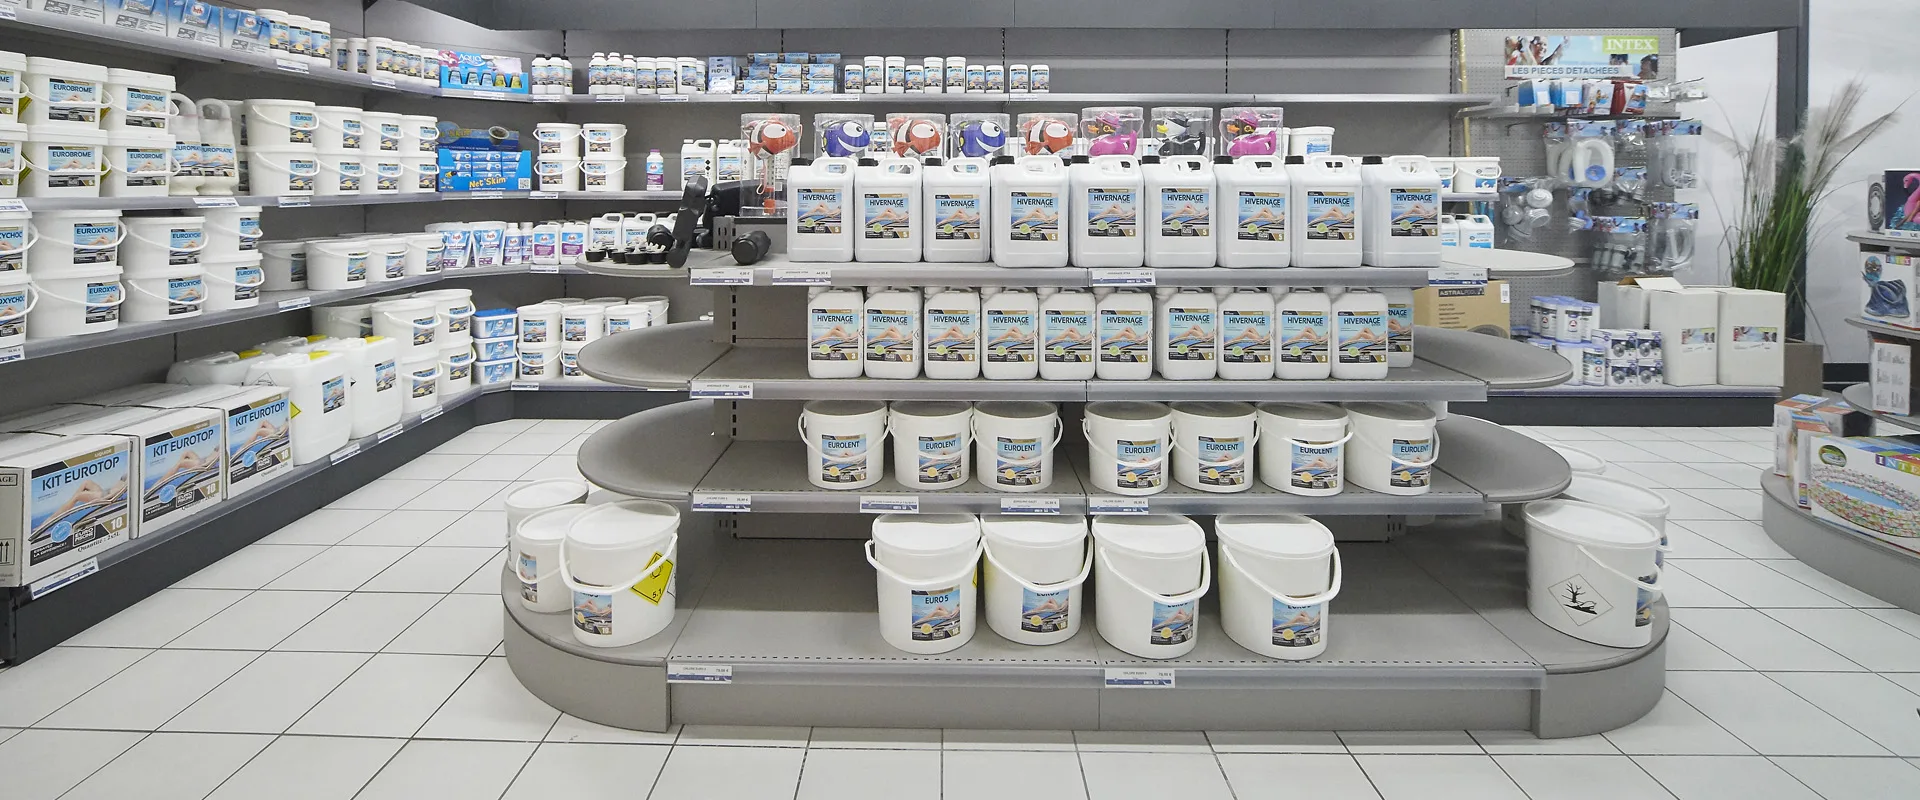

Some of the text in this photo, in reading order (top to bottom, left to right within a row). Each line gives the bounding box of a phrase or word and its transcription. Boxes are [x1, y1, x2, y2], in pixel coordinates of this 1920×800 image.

[1607, 39, 1655, 50] INTEX
[1512, 68, 1529, 76] LES
[53, 84, 92, 93] EUROBROME
[131, 93, 164, 102] EUROBROME
[236, 402, 284, 426] KIT EUROTOP
[154, 430, 213, 457] KIT EUROTOP
[926, 440, 956, 449] EUROLENT
[1125, 446, 1156, 454] EUROLENT
[1400, 445, 1428, 453] EUROLENT
[42, 456, 119, 491] KIT EUROTOP
[206, 483, 216, 494] 10
[111, 516, 122, 530] 10
[925, 595, 944, 604] EURO
